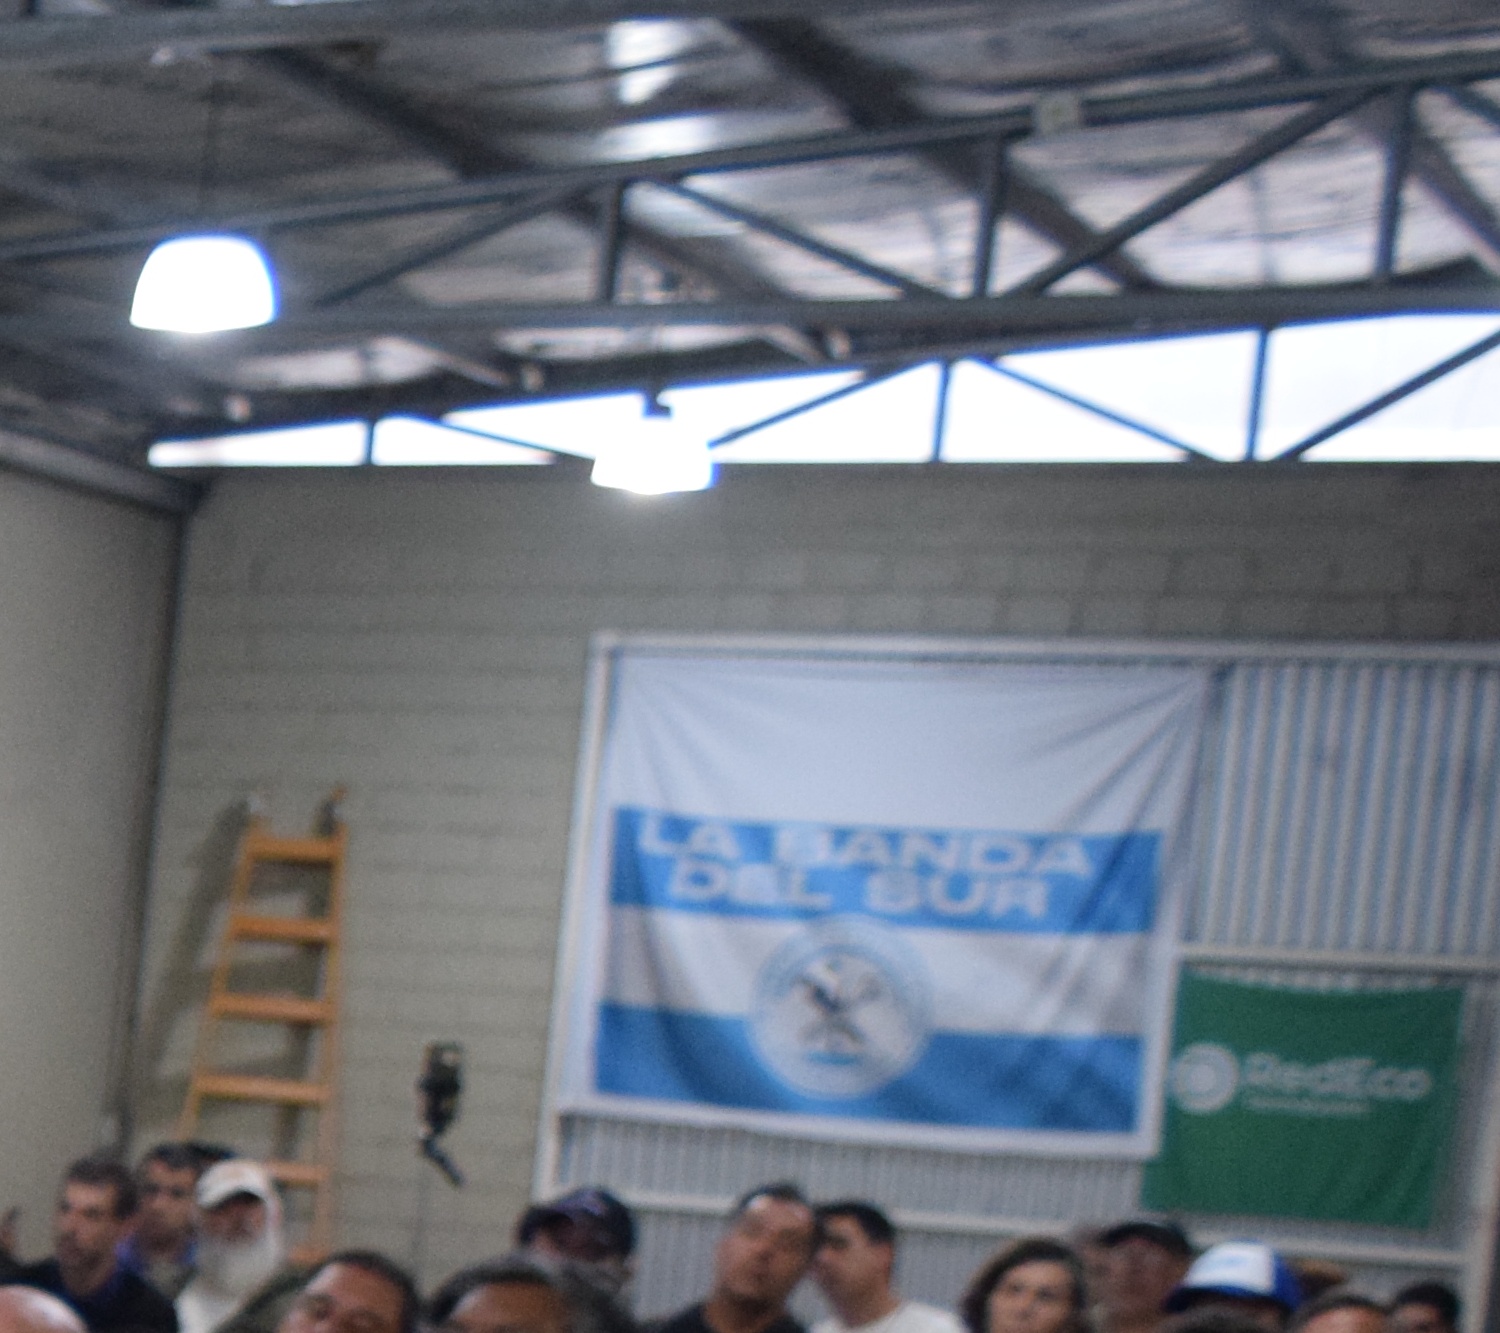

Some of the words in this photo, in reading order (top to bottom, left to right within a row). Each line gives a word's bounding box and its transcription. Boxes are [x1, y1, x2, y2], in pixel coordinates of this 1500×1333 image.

[637, 814, 740, 862] LA
[773, 826, 1094, 879] BANDA
[667, 857, 834, 911] DEL
[863, 868, 1052, 920] SUR
